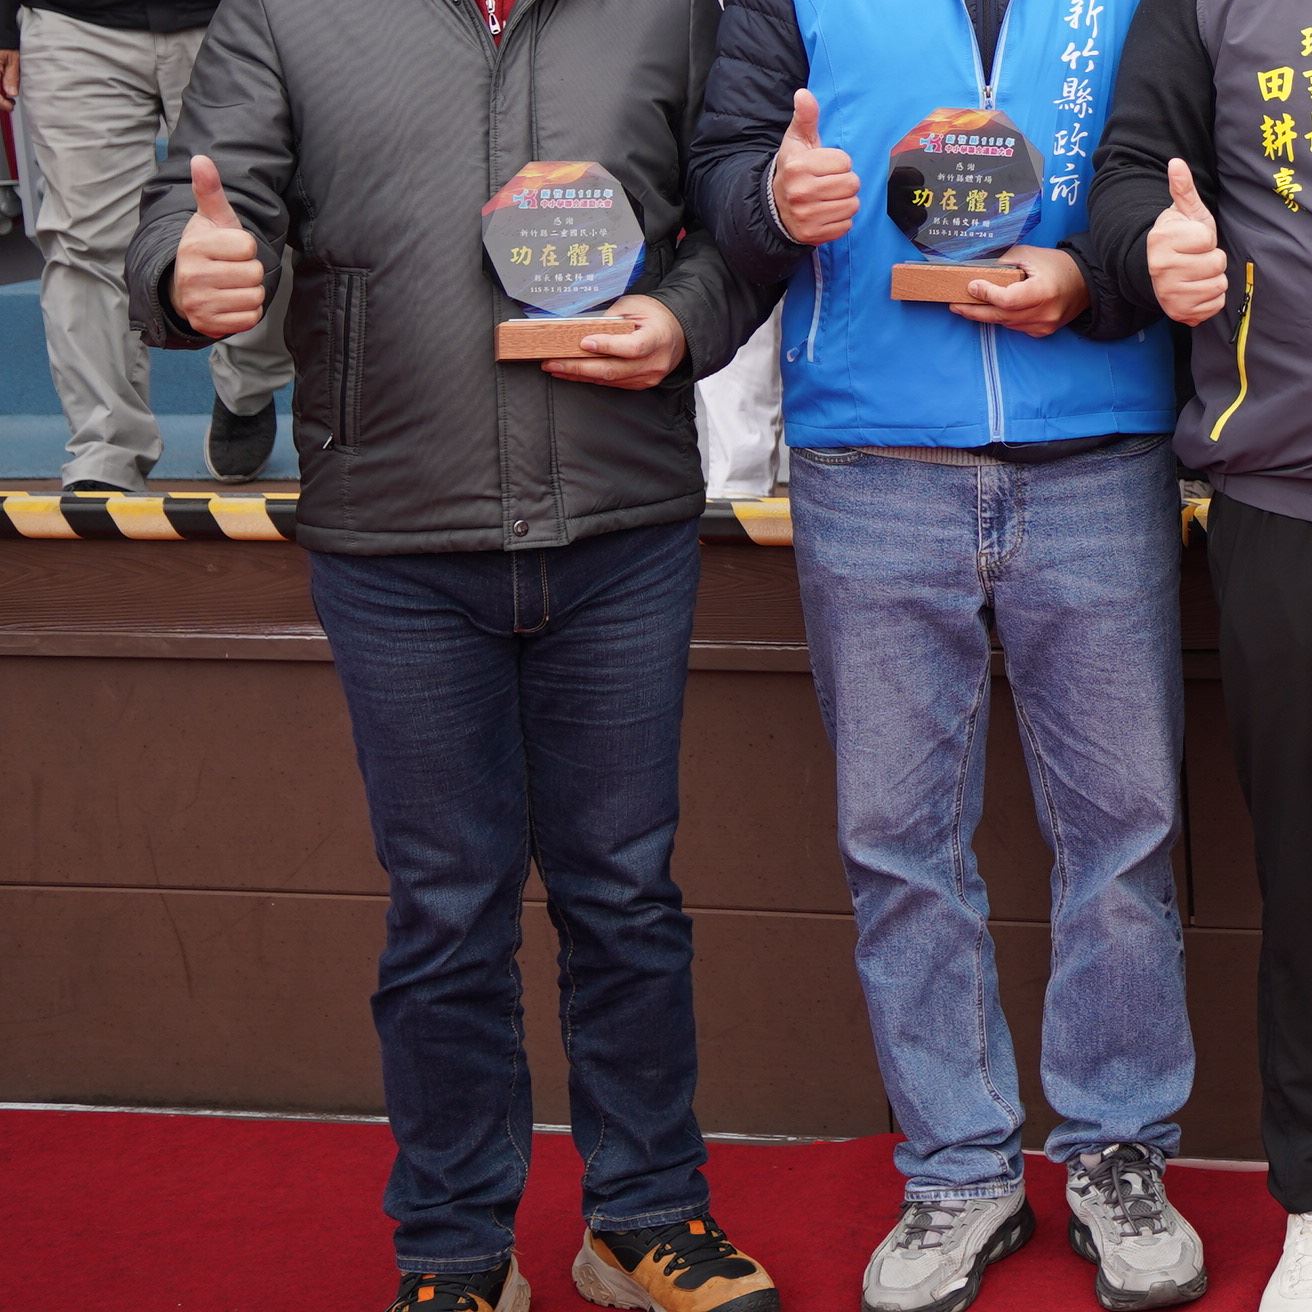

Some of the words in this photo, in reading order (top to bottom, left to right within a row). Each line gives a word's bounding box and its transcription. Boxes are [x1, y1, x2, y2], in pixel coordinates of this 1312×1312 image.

[912, 188, 1015, 214] 功在體育
[510, 243, 618, 267] 功在體育
